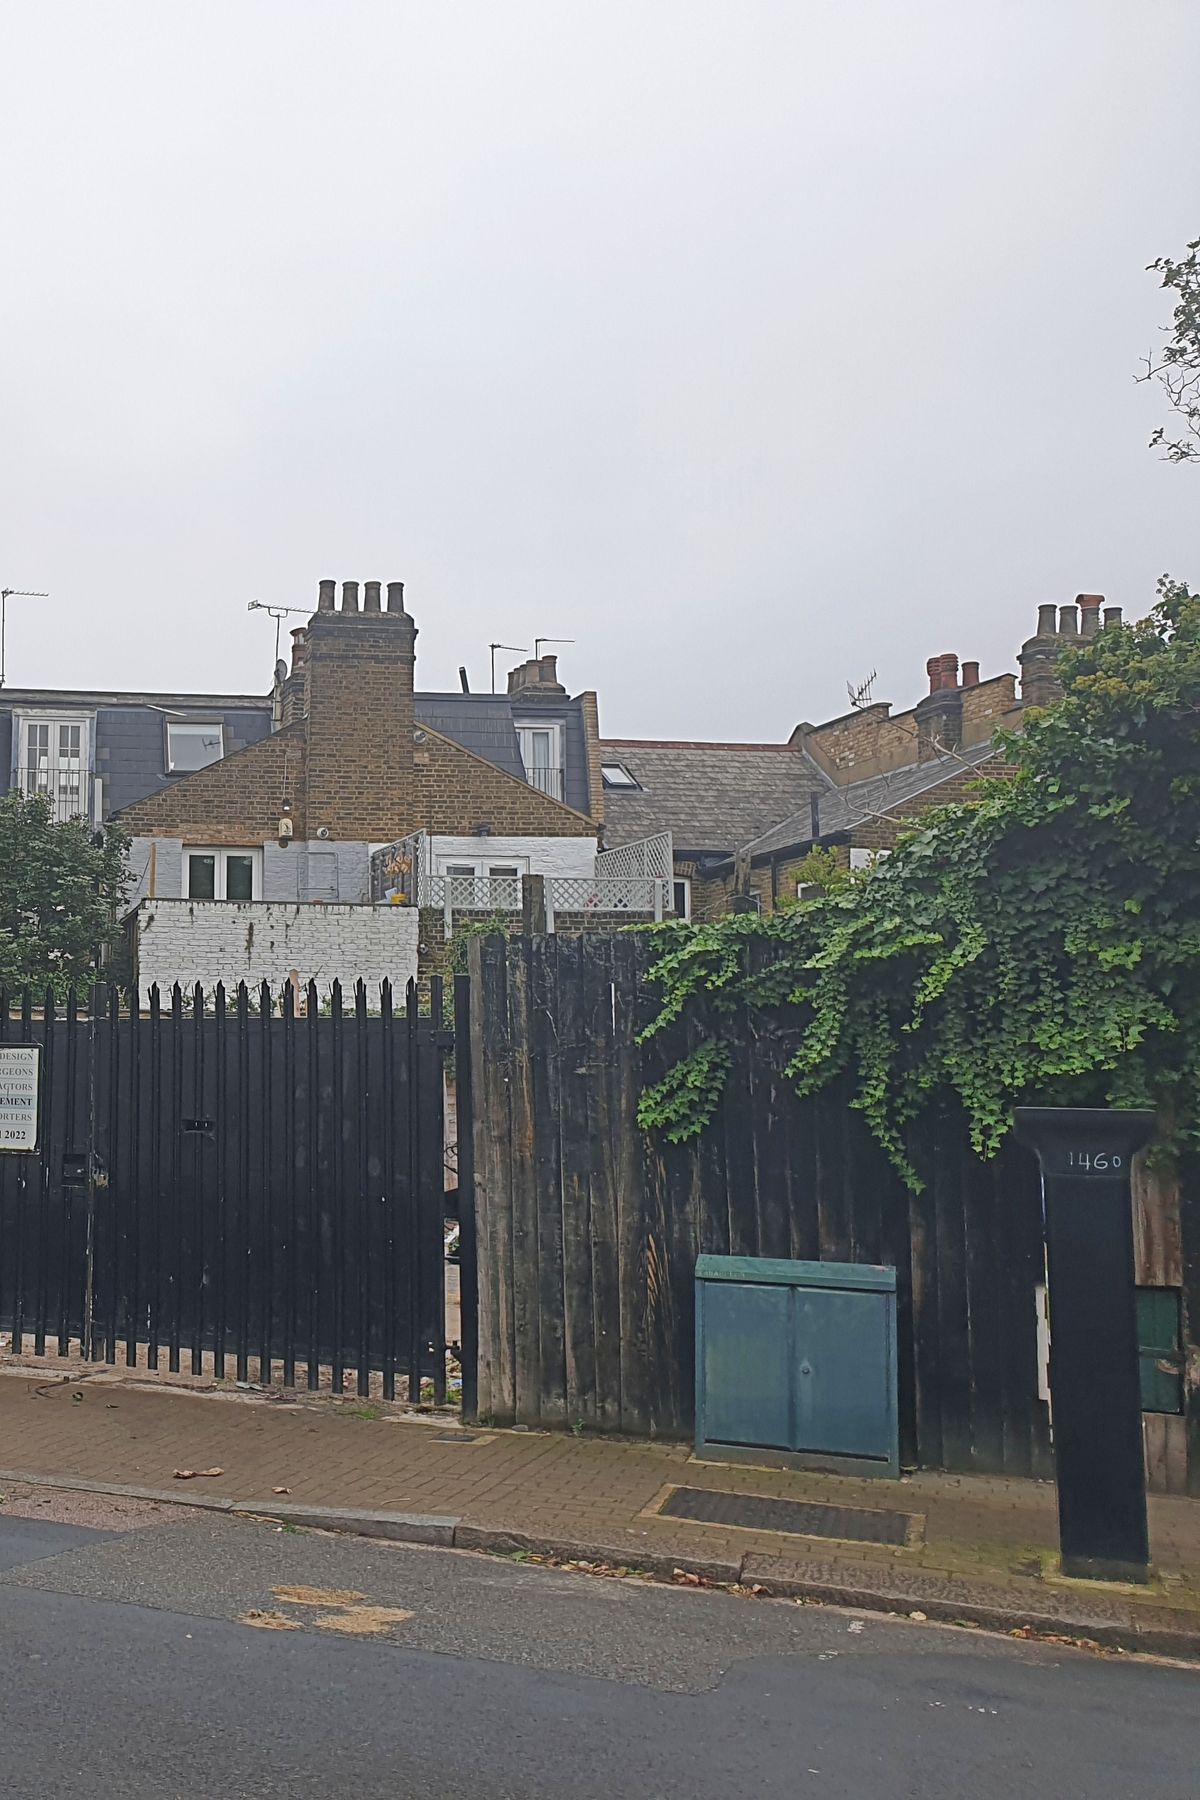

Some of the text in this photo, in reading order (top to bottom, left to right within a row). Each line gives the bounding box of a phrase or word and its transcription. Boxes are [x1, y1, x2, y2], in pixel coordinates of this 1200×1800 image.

[0, 1052, 34, 1061] DESIGN
[5, 1130, 26, 1140] 2022
[1069, 1151, 1122, 1170] 1460
